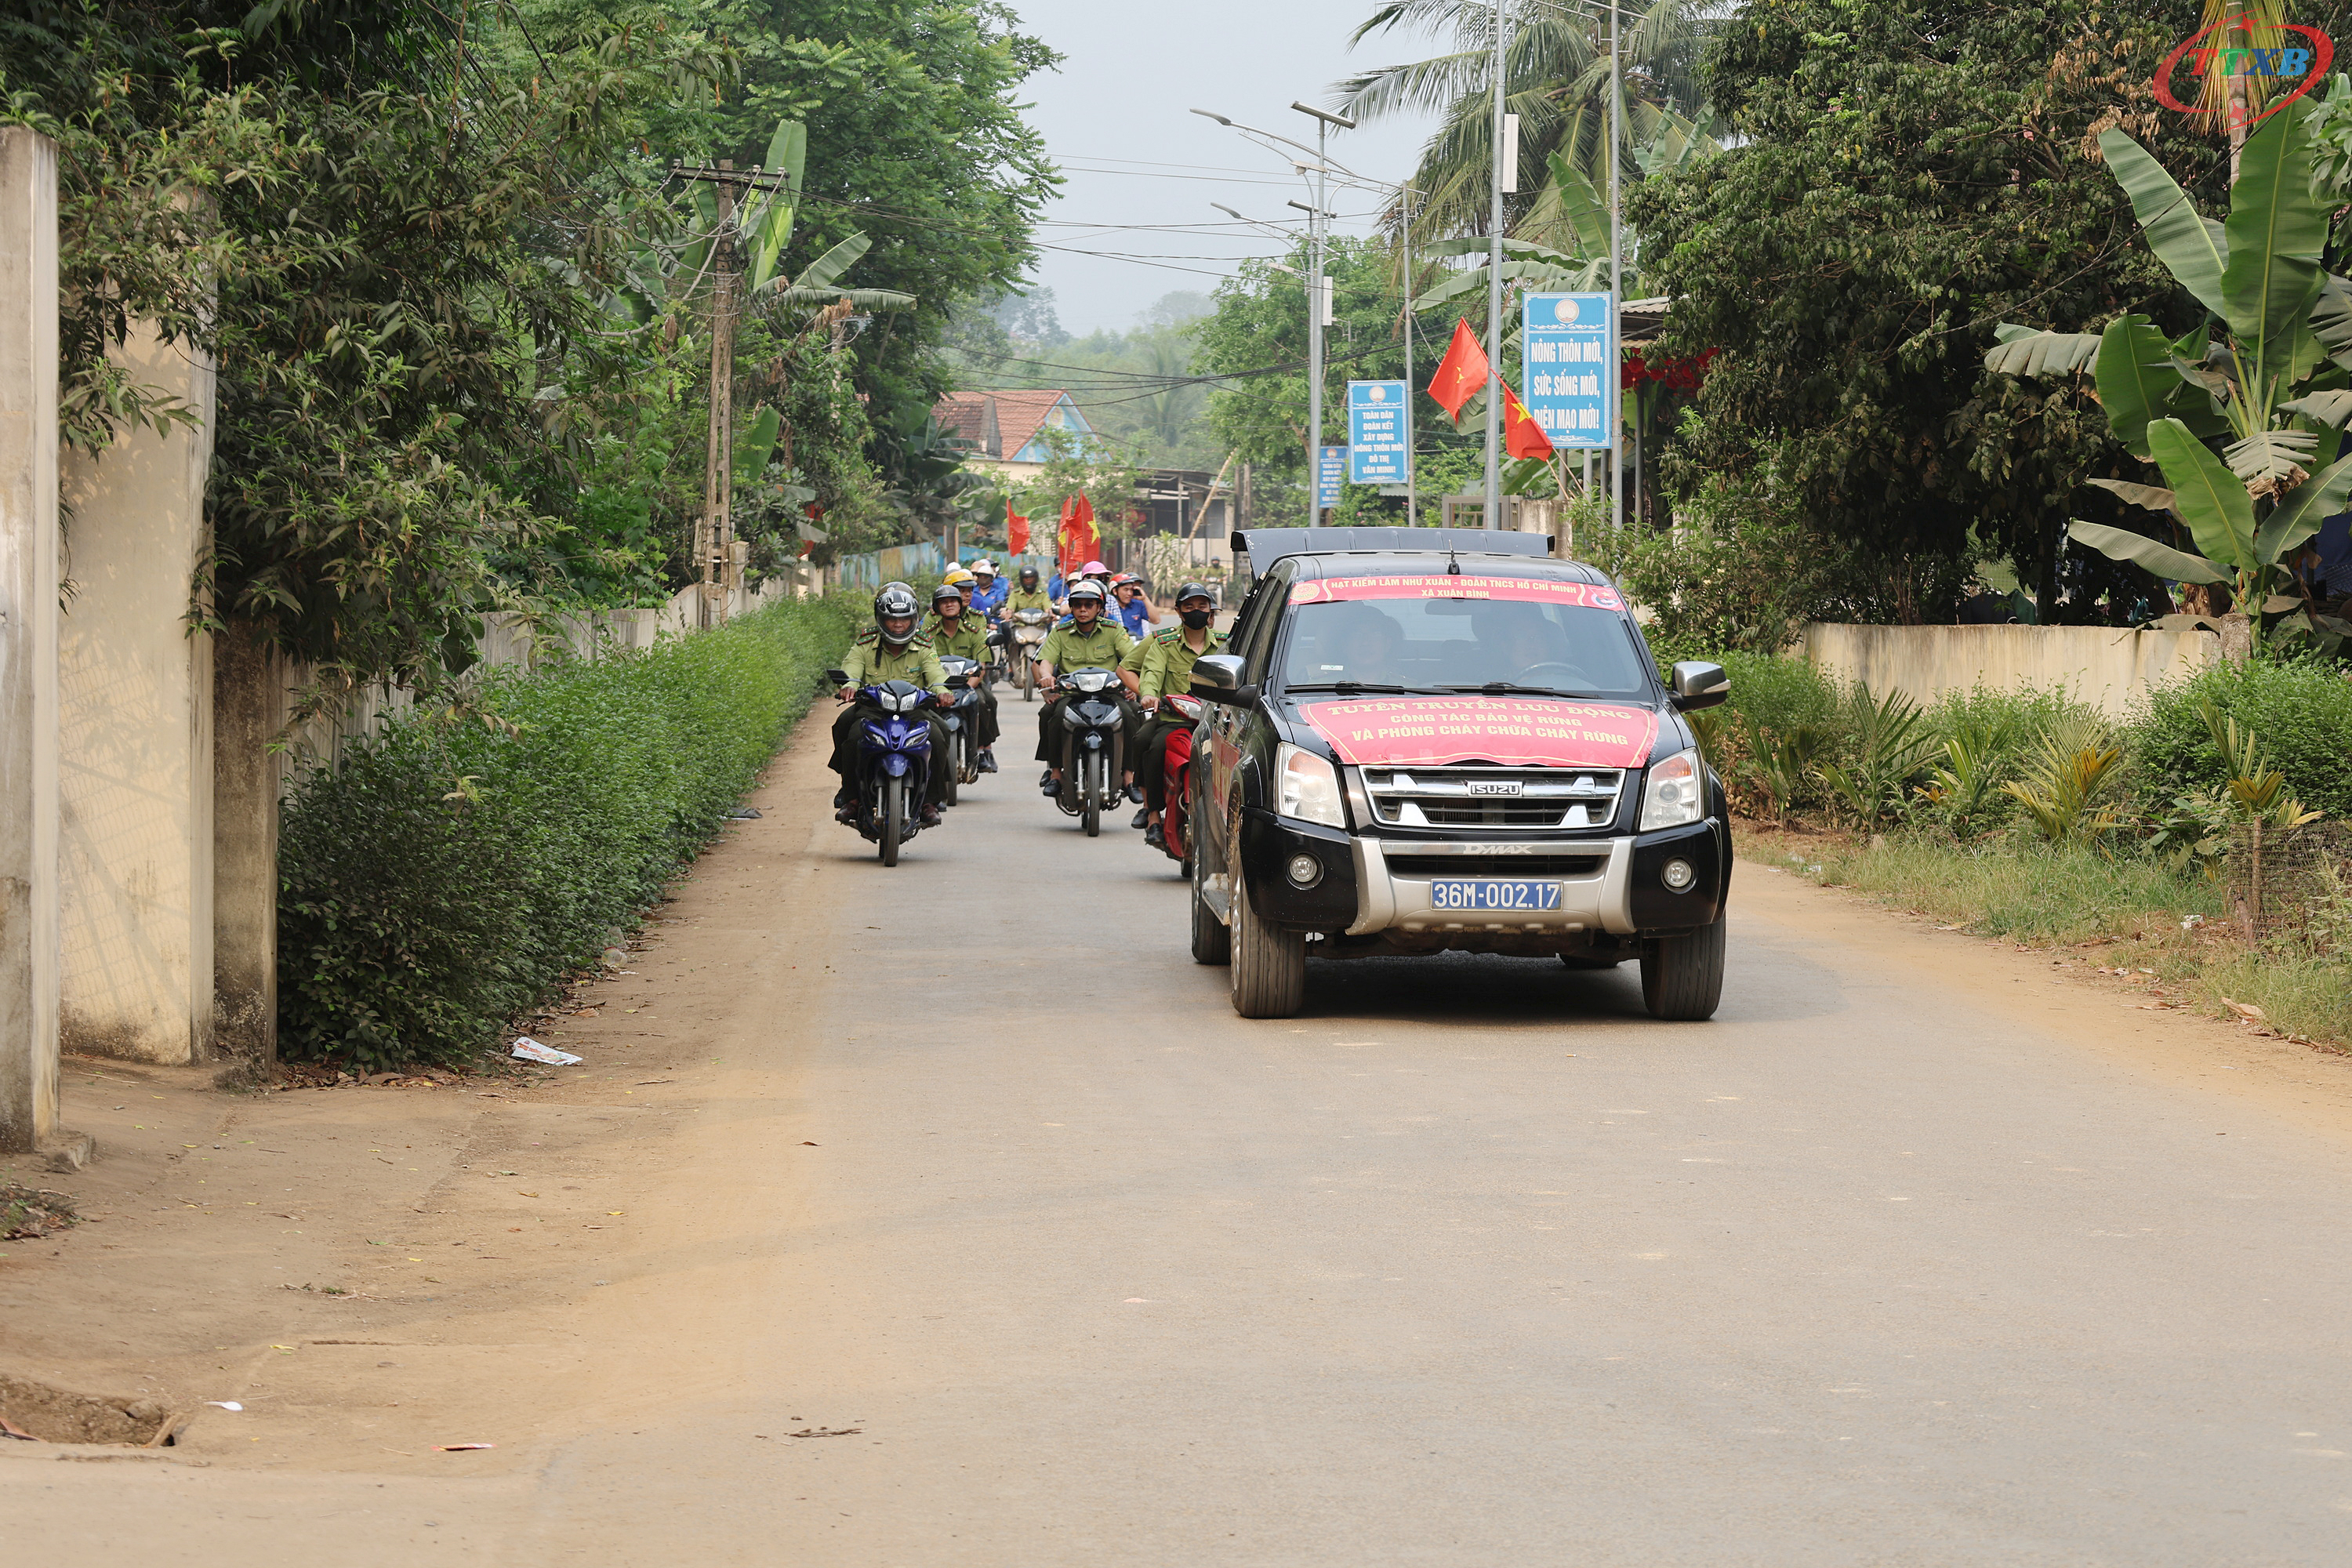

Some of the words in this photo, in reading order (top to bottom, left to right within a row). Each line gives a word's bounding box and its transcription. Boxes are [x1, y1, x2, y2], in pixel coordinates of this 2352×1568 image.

[1531, 338, 1555, 362] NÔNG
[1558, 338, 1581, 362] THÔN
[1583, 336, 1602, 365] MỚI,
[1534, 370, 1552, 396] SỨC
[1554, 368, 1577, 396] SỐNG
[1580, 369, 1599, 397] MỚI,
[1381, 410, 1394, 419] DÂN
[1557, 408, 1577, 433] MẠO
[1579, 403, 1599, 429] MỚI!
[1354, 443, 1372, 452] NÔNG
[1373, 443, 1390, 452] THÔN
[1352, 577, 1377, 587] KIỂM
[1403, 578, 1423, 586] NHƯ
[1461, 579, 1487, 587] ĐOÀN
[1533, 583, 1548, 591] CHÍ
[1551, 584, 1577, 593] MINH
[1327, 702, 1406, 715] TUYÊN
[1412, 699, 1507, 710] TRUYỀN
[1512, 702, 1559, 712] LƯU
[1568, 706, 1632, 720] ĐỘNG
[1390, 713, 1436, 723] CÔNG
[1439, 713, 1471, 721] TÁC
[1475, 712, 1508, 722] BẢO
[1512, 715, 1534, 724] VỆ
[1537, 716, 1583, 727] RỪNG
[1352, 728, 1374, 741] VÀ
[1377, 727, 1436, 739] PHÒNG
[1439, 724, 1483, 735] CHÁY
[1487, 725, 1532, 736] CHỮA
[1536, 728, 1577, 739] CHÁY
[1582, 730, 1629, 746] RỪNG
[1472, 786, 1519, 795] ISUZU
[1434, 883, 1560, 908] 36M-002.17
